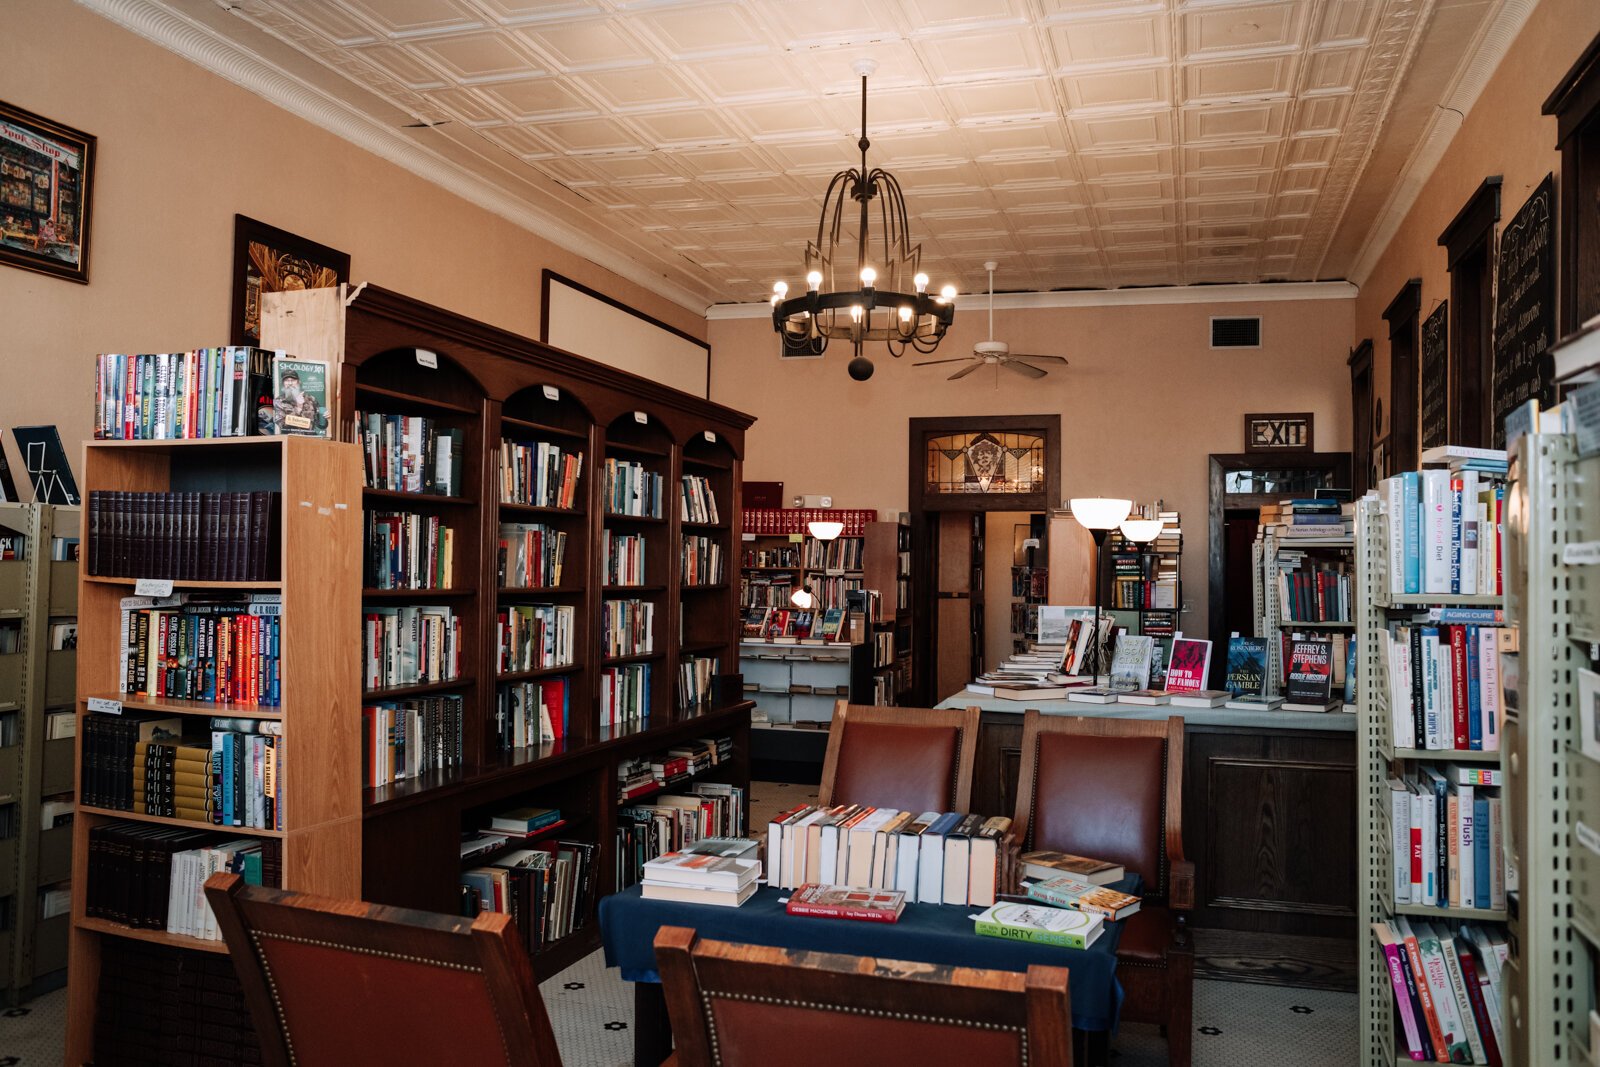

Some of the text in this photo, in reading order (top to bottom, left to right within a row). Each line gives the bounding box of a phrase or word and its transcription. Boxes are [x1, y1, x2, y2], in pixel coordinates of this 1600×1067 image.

[31, 138, 61, 158] Shop
[1527, 345, 1536, 368] go
[1252, 421, 1307, 445] EXIT
[1451, 492, 1461, 582] Safer Than Phen-Fen!
[1435, 546, 1443, 562] Diet
[1394, 550, 1402, 577] Squirrel?
[196, 606, 212, 614] JACKSON
[264, 605, 279, 614] ROBB
[1454, 630, 1462, 647] Craig
[138, 640, 146, 666] CORNWELL
[1293, 644, 1328, 655] JEFFREY S.
[1118, 656, 1144, 665] CLARK
[1292, 654, 1328, 665] STEPHENS
[1455, 648, 1463, 681] Claiborne's
[1170, 669, 1193, 678] HOW TO
[1227, 673, 1261, 681] PERSIAN
[1306, 673, 1328, 681] MISSION
[1168, 678, 1200, 688] BE FAMOUS
[1226, 681, 1260, 689] GAMBLE
[1456, 681, 1464, 709] Gourmet
[1486, 681, 1496, 707] Living
[1427, 712, 1436, 735] COOPER
[166, 785, 171, 793] IV
[166, 808, 172, 816] VI
[1463, 816, 1473, 847] Flush
[1033, 892, 1048, 901] Dying
[792, 906, 810, 914] DEBBIE
[810, 908, 838, 916] MACOMBER
[1000, 927, 1073, 946] DIRTY GENES
[1389, 956, 1402, 984] Curves
[1408, 942, 1431, 1008] 21 POUNDS 21 DAYS
[1433, 957, 1446, 989] Healing
[1445, 946, 1469, 1009] THE PRINCETON PLAN
